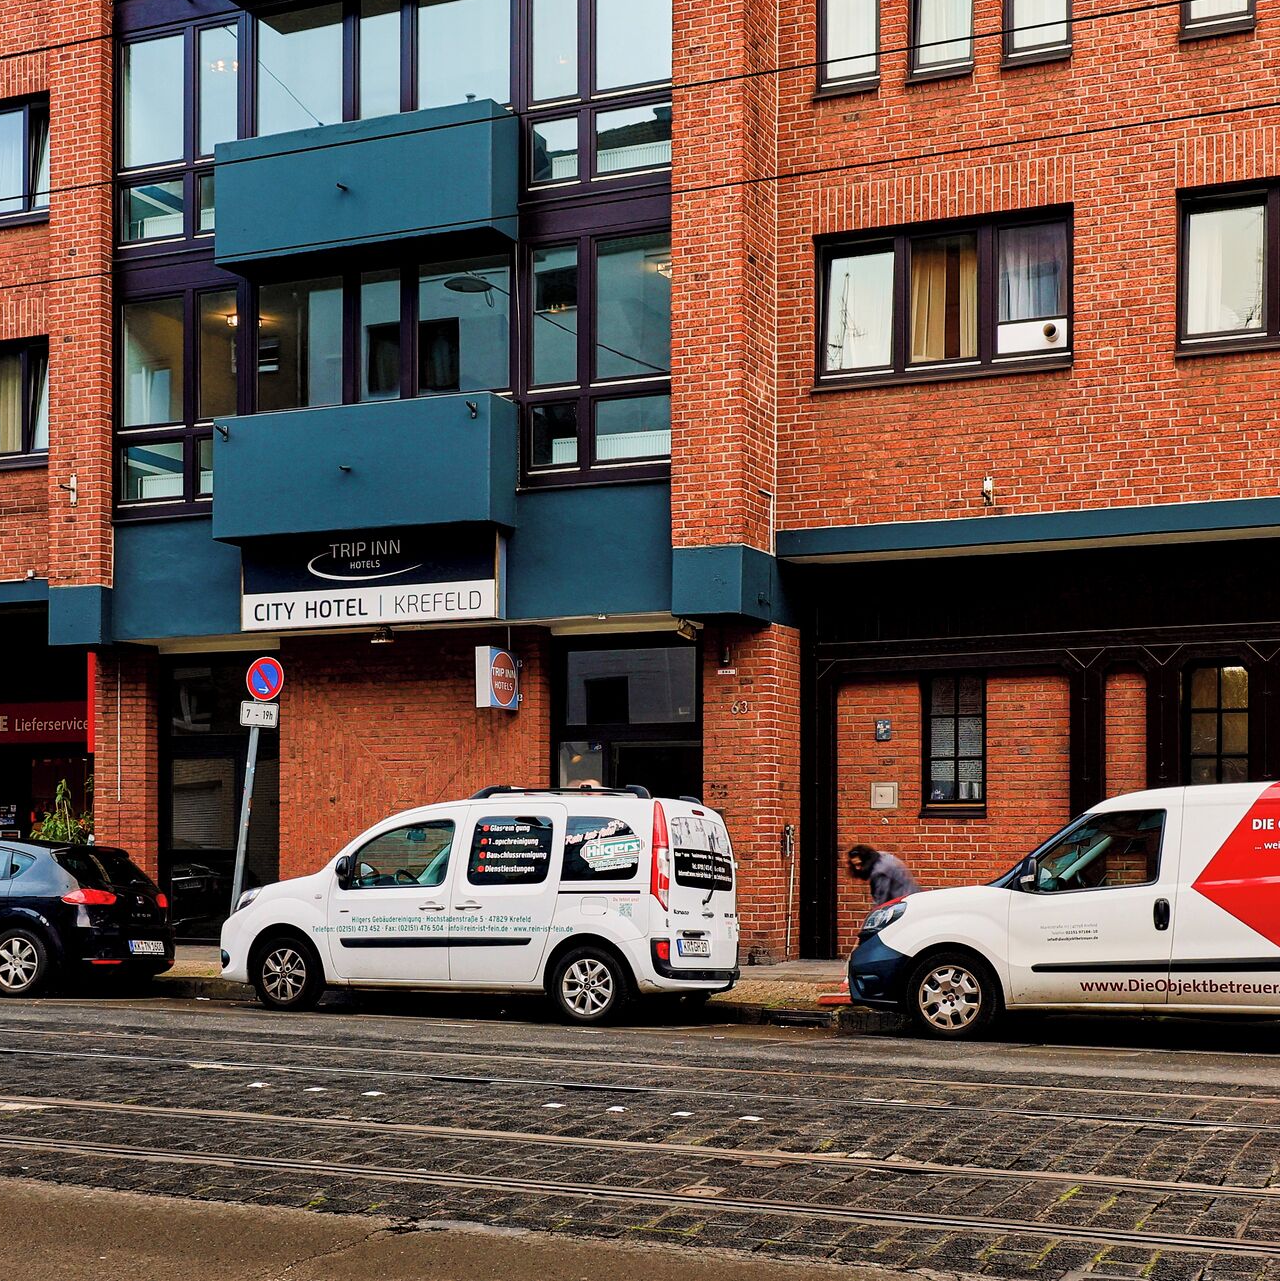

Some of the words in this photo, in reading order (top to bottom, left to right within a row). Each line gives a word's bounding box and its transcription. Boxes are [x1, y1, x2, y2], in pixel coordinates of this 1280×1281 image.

[329, 542, 366, 558] TRIP
[372, 539, 401, 555] INN
[350, 559, 381, 569] HOTELS
[254, 601, 295, 621] CITY
[305, 598, 368, 619] HOTEL
[394, 590, 482, 614] KREFELD
[492, 667, 504, 677] TRIP
[505, 669, 516, 678] INN
[495, 681, 512, 691] HOTELS
[731, 700, 748, 714] 63
[246, 709, 251, 718] 7
[263, 711, 273, 720] 19h
[15, 717, 88, 732] Lieferservice
[1252, 818, 1274, 830] DIE
[586, 842, 640, 858] Hilgers
[485, 865, 535, 874] Dienstleistungen
[513, 923, 574, 933] www.rein-ist-fein.de
[701, 943, 707, 952] 29
